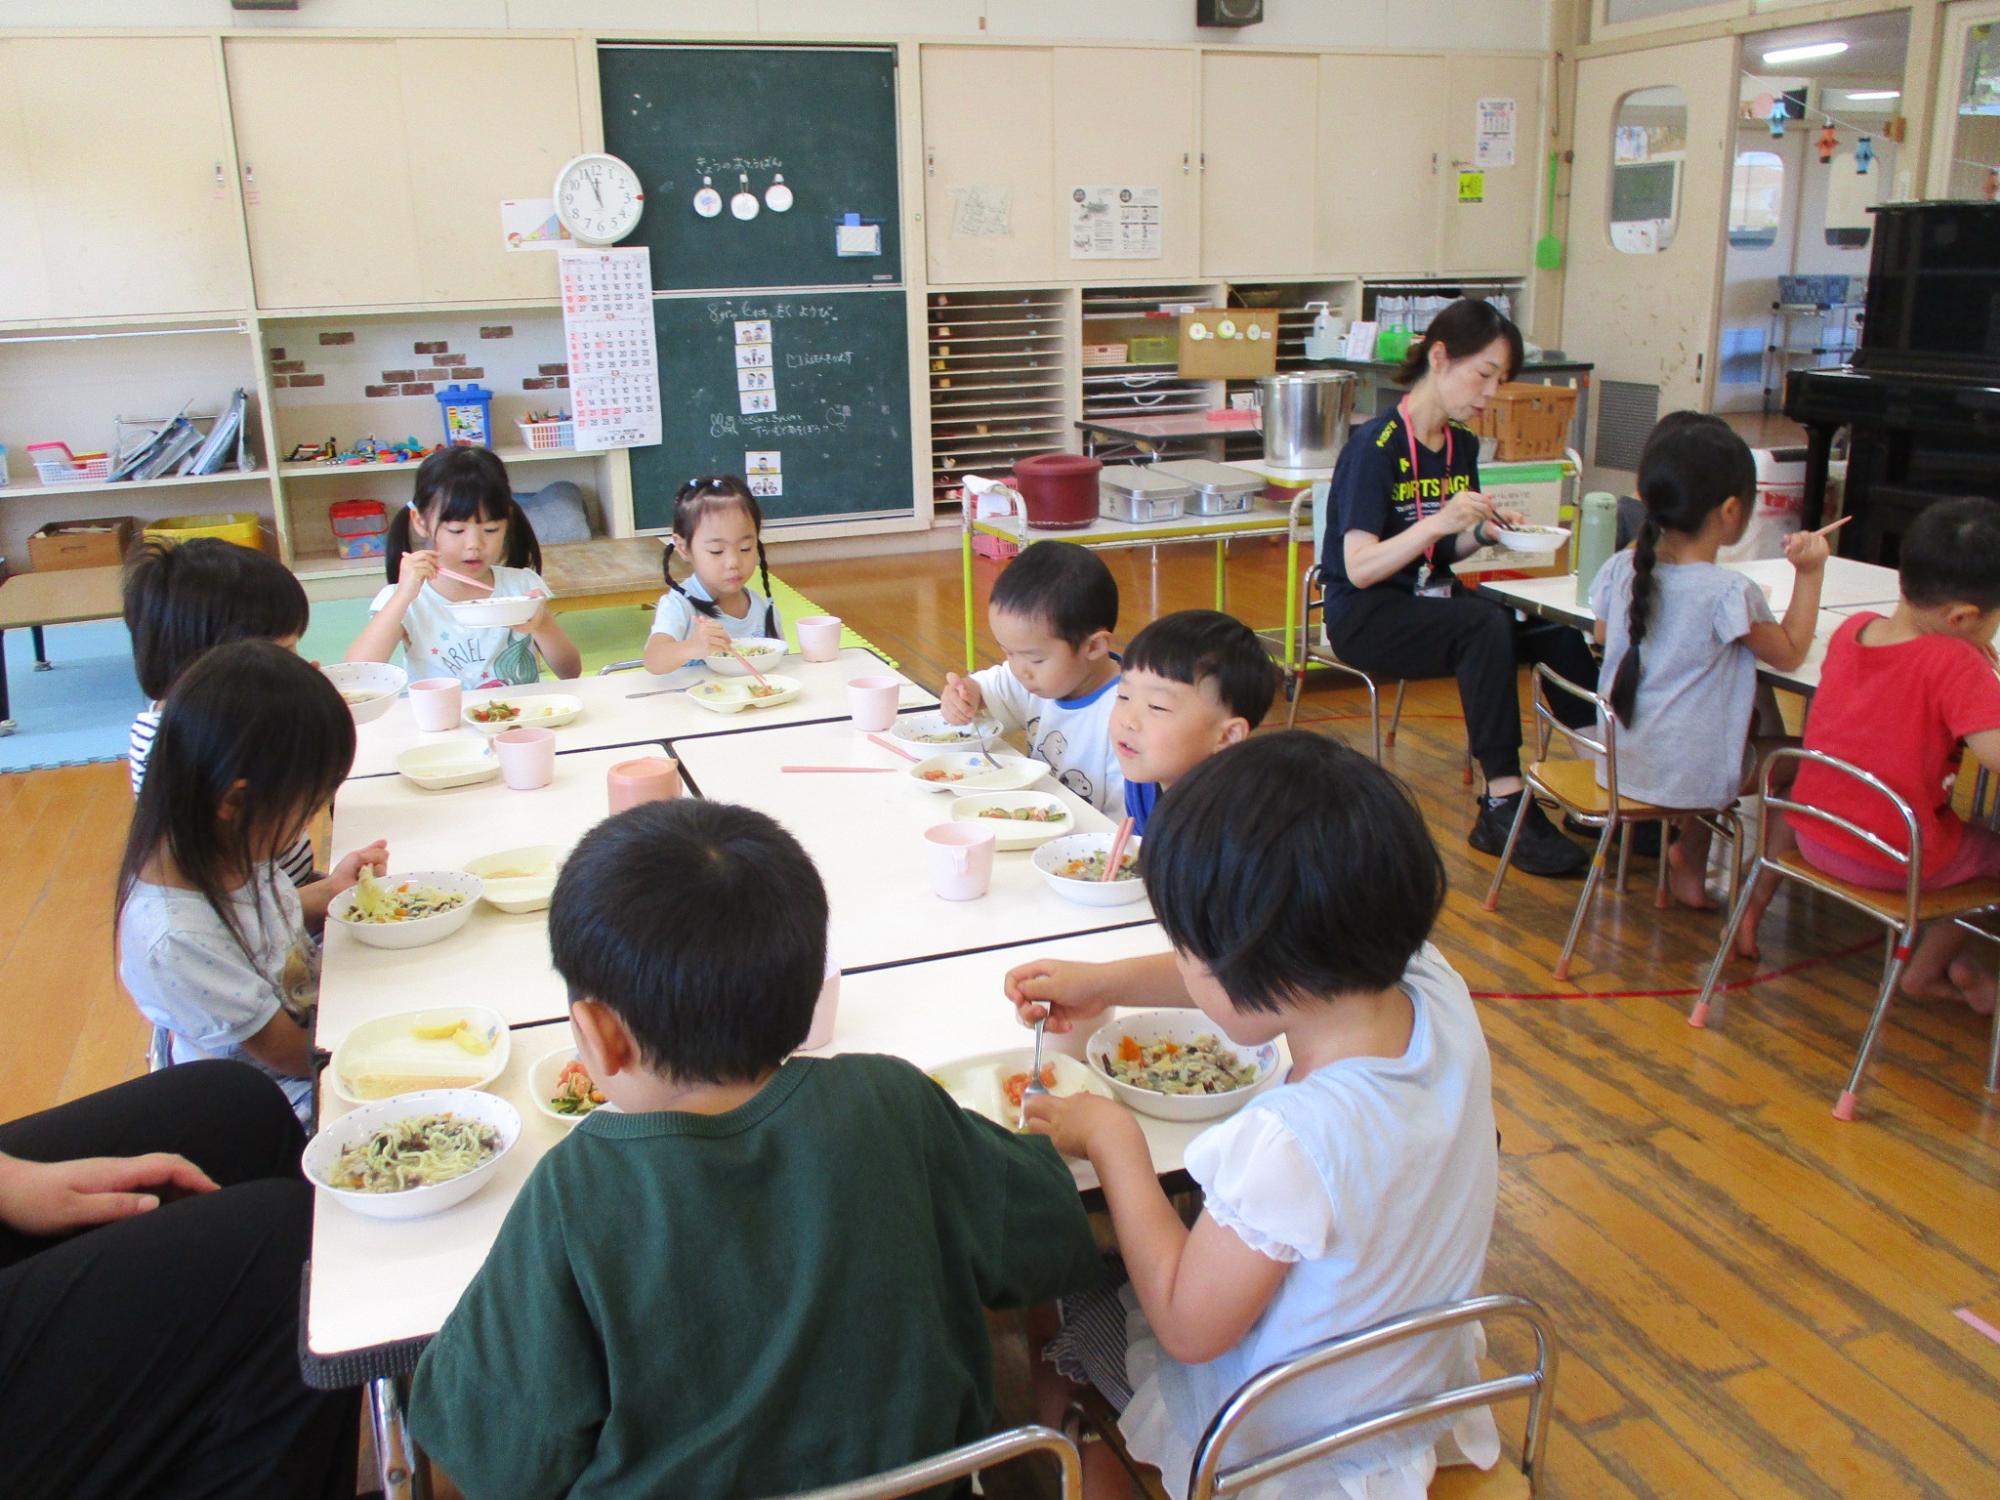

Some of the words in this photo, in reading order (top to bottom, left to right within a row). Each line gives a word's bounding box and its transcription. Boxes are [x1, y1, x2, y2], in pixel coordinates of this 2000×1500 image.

[591, 164, 602, 176] 12
[570, 179, 580, 191] 10
[618, 177, 625, 189] 2
[565, 193, 574, 206] 9
[624, 192, 631, 205] 3
[571, 207, 580, 220] 8
[618, 210, 627, 219] 4
[584, 217, 592, 229] 7
[596, 220, 606, 233] 6
[610, 216, 618, 228] 5
[441, 638, 486, 675] ARIEL
